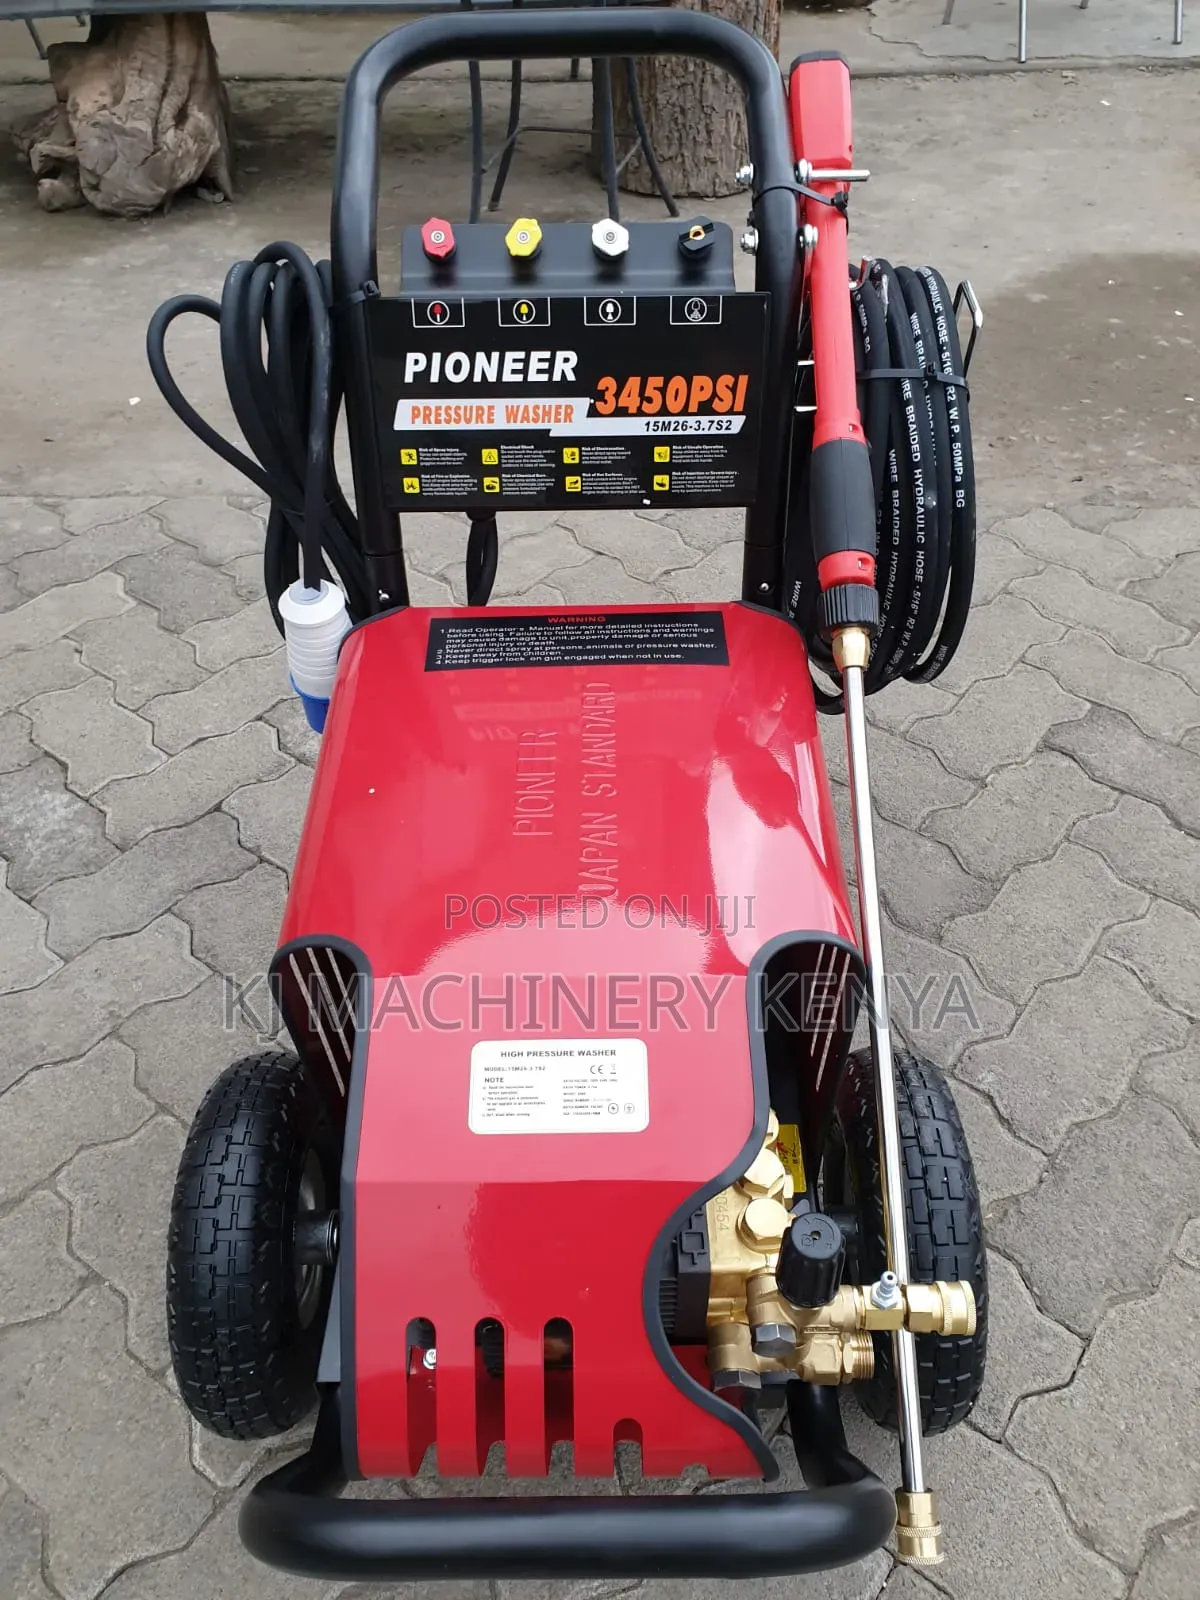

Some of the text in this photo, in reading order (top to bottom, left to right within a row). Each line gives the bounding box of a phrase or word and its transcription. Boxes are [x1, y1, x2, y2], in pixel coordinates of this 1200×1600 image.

[910, 312, 921, 338] WIRE
[936, 315, 949, 344] HOSE
[404, 351, 578, 383] PIONEER
[595, 375, 748, 415] 3450PSI
[946, 385, 957, 402] R2
[411, 404, 574, 424] PRESSURE WASHER
[644, 420, 732, 432] 15M26-3.7S2
[905, 405, 921, 462] BRAIDED
[889, 448, 898, 483] WIRE
[952, 442, 964, 482] 50MPa
[914, 468, 926, 544] HYDRAULIC
[955, 489, 965, 508] BG
[891, 490, 900, 545] BRAIDED
[883, 551, 899, 611] HYDRAULIC
[915, 550, 925, 583] HOSE
[791, 580, 802, 608] WIRE
[581, 682, 617, 798] STANDARD
[500, 1049, 617, 1058] HIGH PRESSURE WASHER
